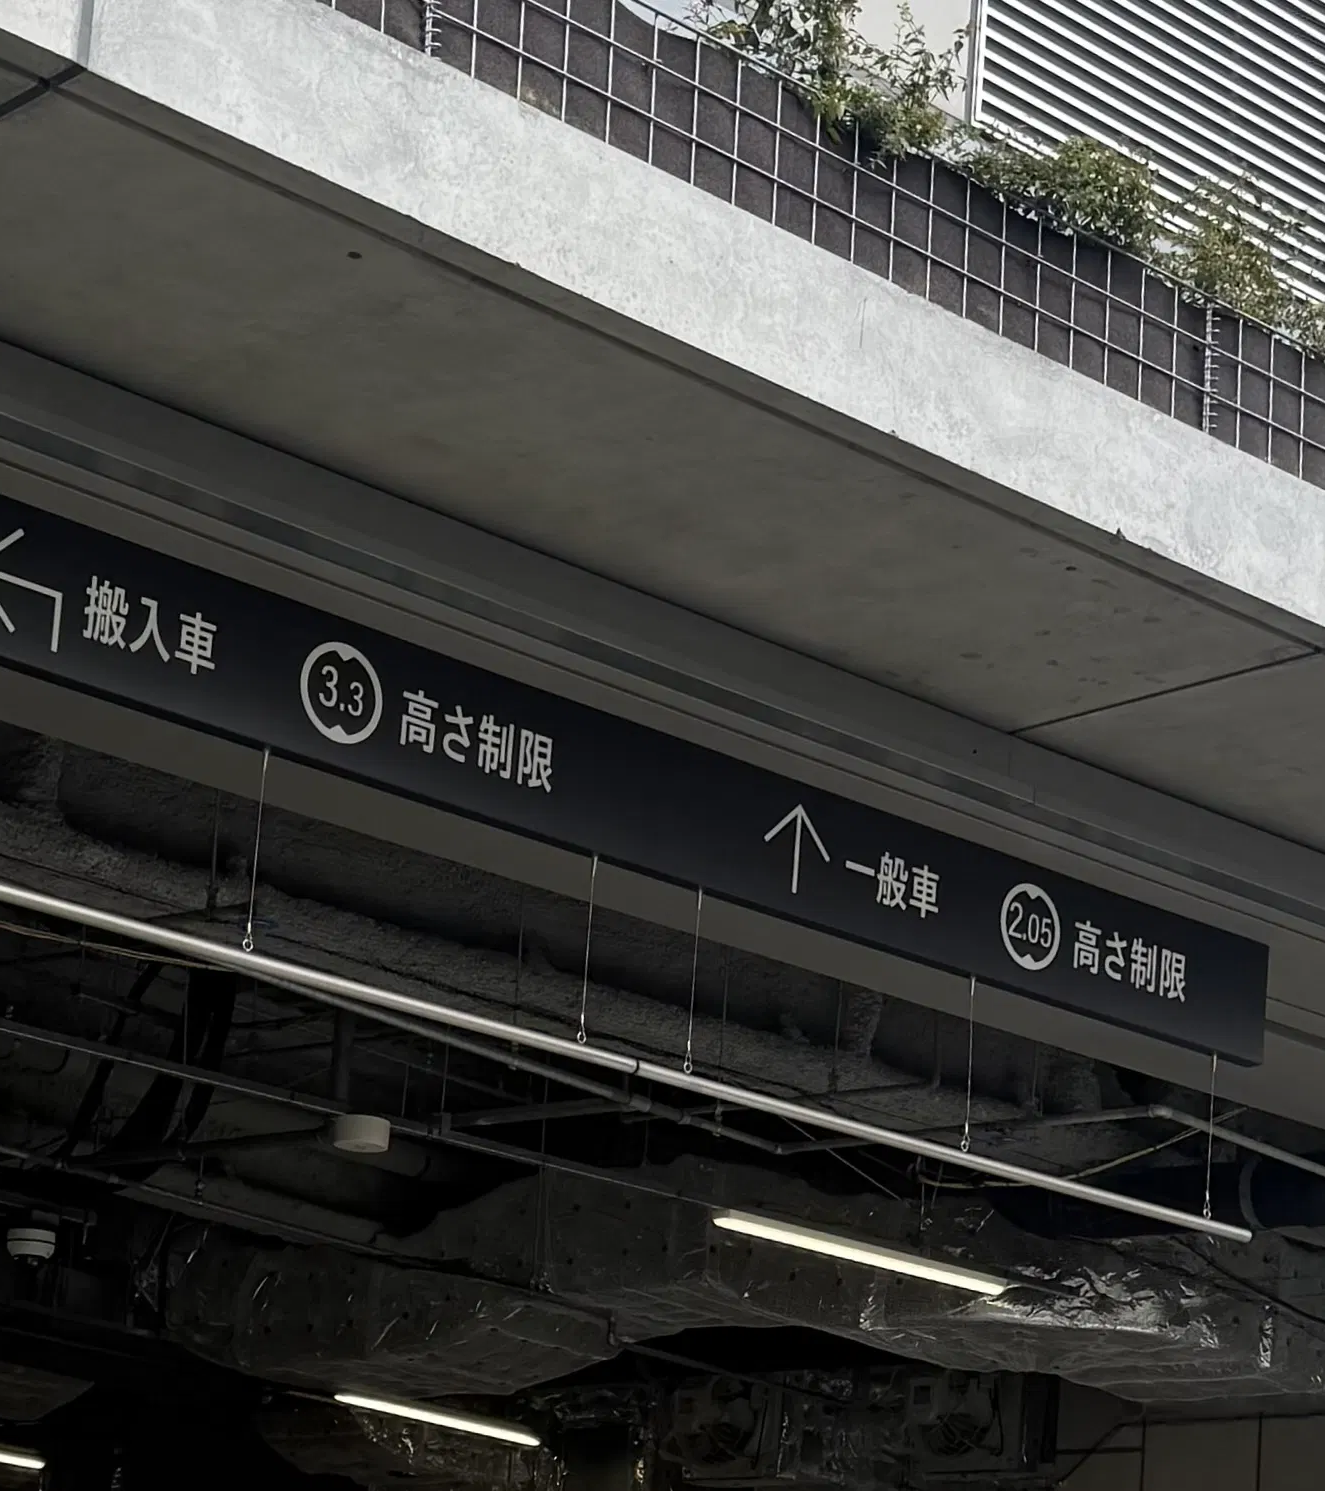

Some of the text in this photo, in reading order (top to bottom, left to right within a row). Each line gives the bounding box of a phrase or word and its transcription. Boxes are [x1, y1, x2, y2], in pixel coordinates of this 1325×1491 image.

[83, 575, 554, 793] 搬入車 3.3 高さ制限
[845, 851, 1186, 1002] 一般車 2.05 高さ制限
